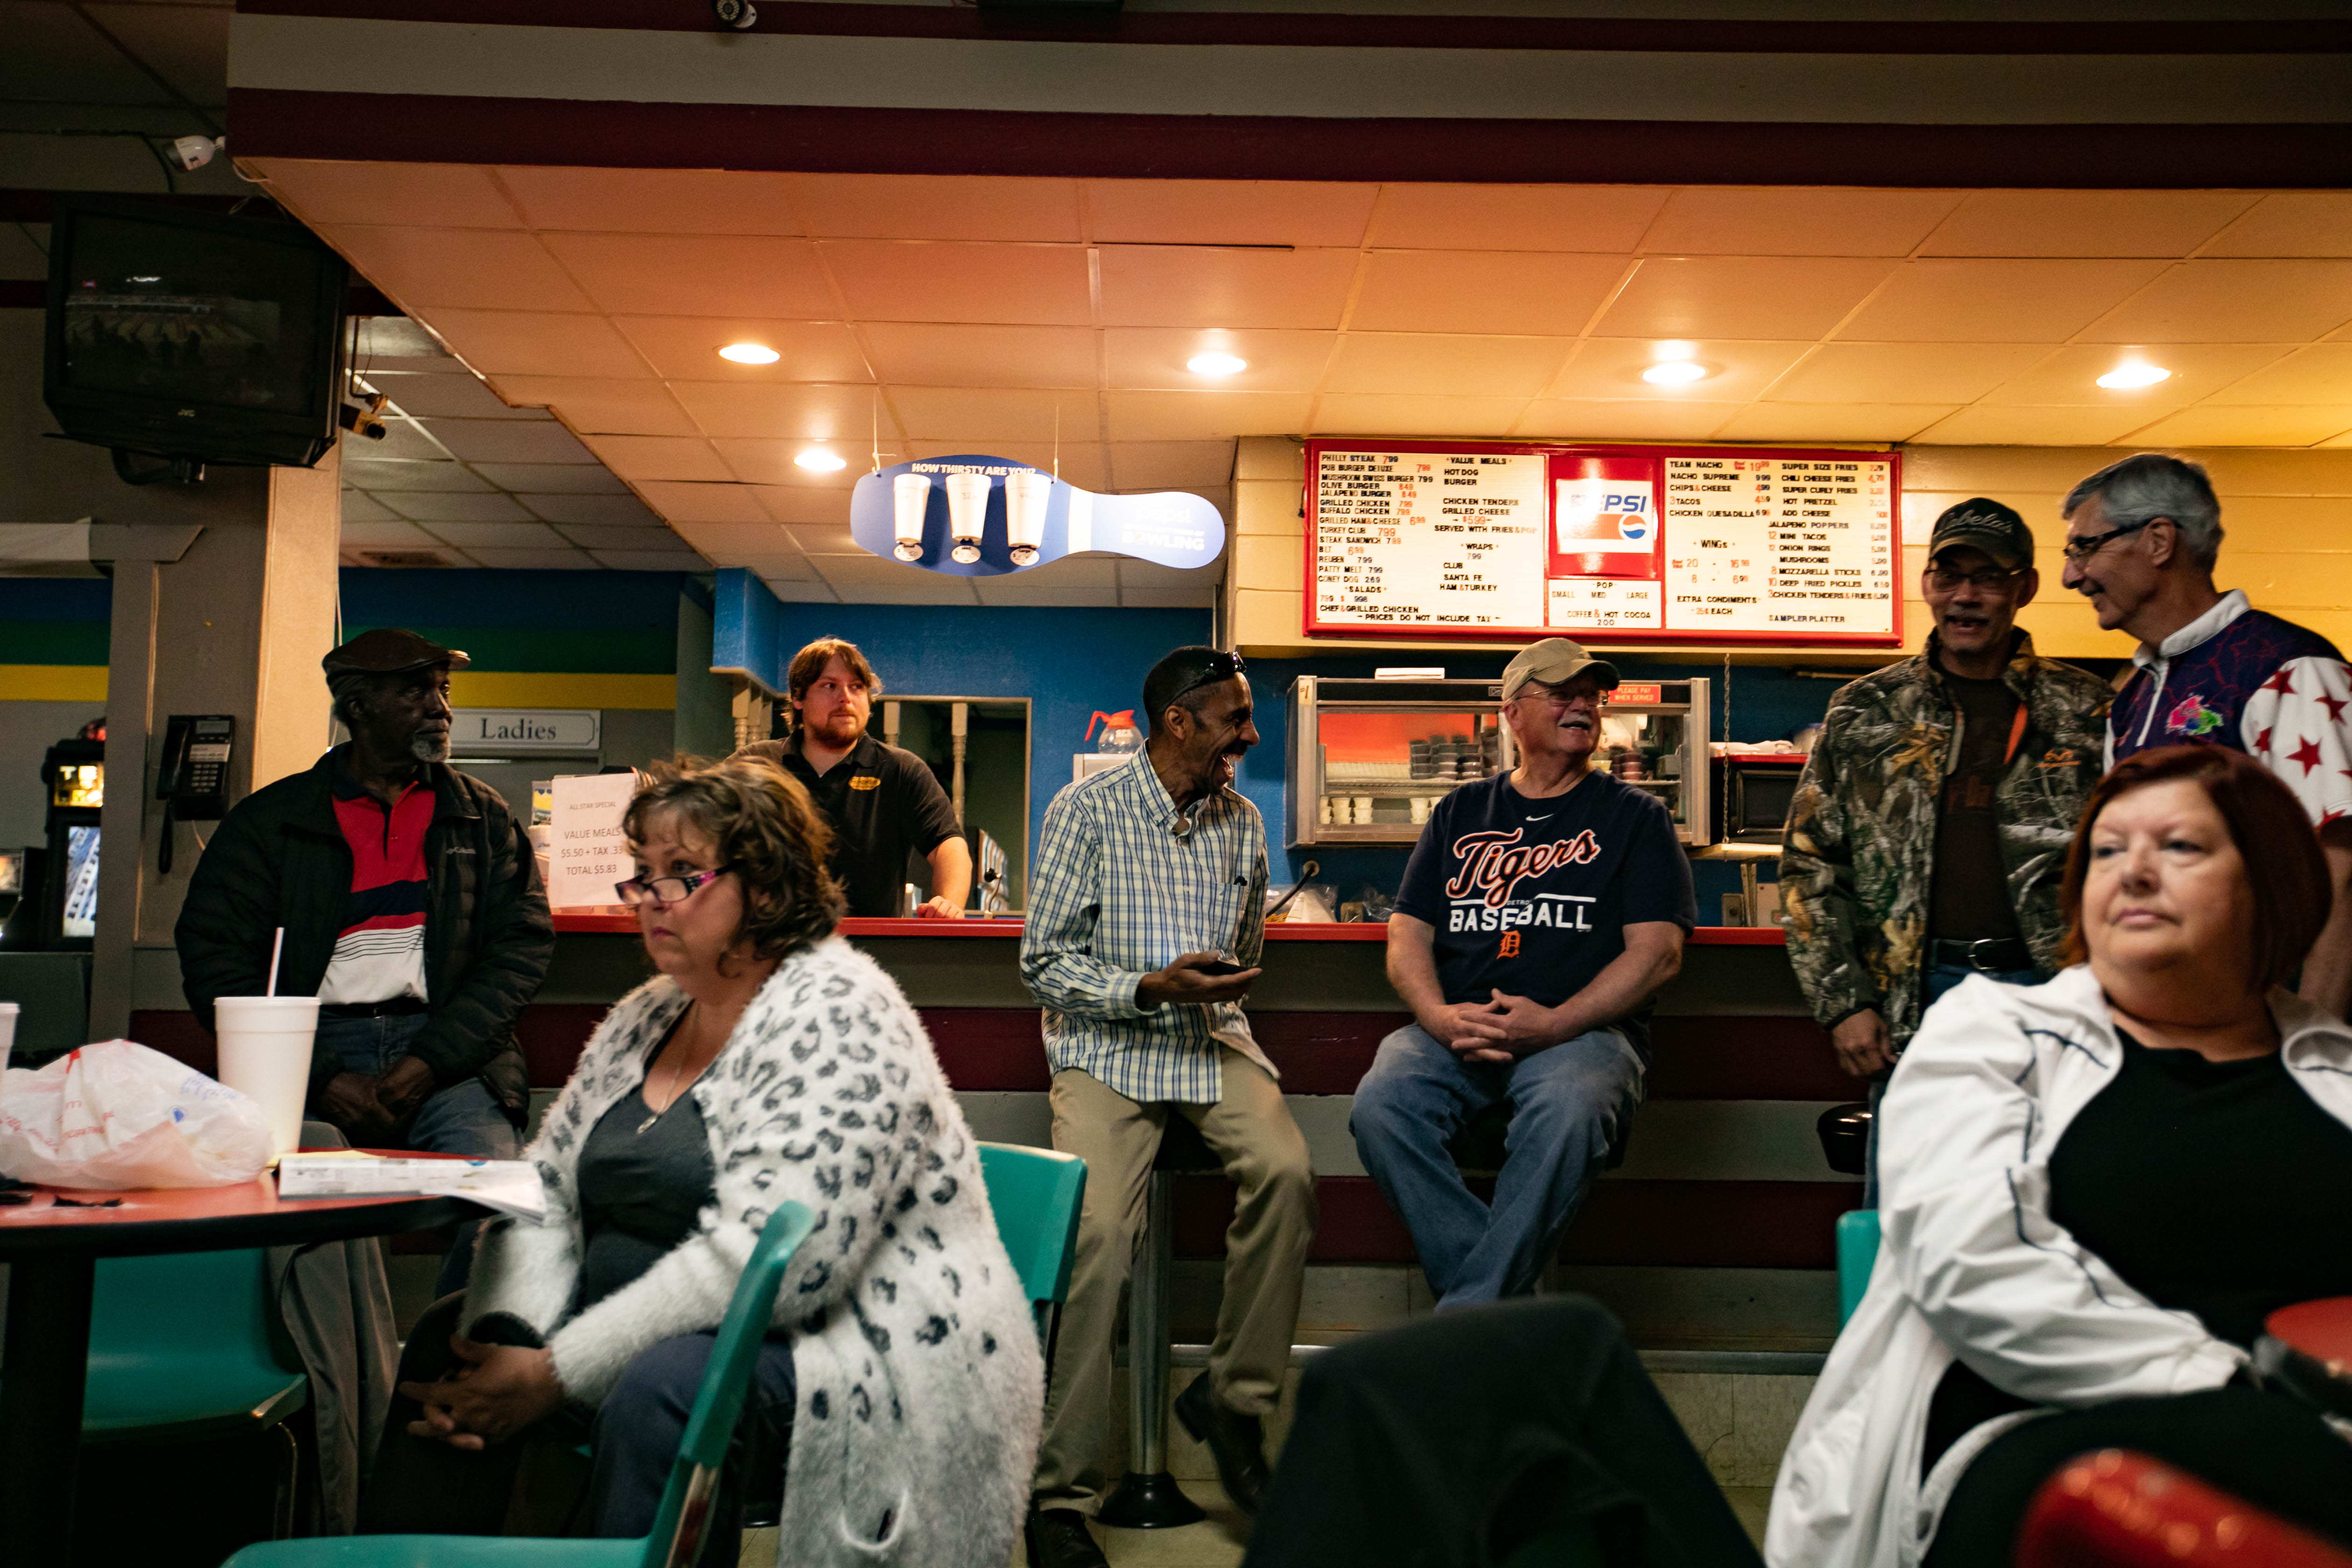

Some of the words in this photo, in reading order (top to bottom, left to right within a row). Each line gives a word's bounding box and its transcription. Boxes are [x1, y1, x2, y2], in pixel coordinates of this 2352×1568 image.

[1383, 455, 1398, 464] 799
[912, 463, 939, 473] HOW
[940, 464, 986, 474] THIRSTY
[985, 466, 1007, 476] ARE
[1687, 559, 1698, 567] 20
[481, 717, 556, 740] Ladies
[564, 830, 590, 839] VALUE
[593, 828, 621, 837] MEALS
[561, 848, 583, 858] $5.50
[567, 866, 592, 875] TOTAL
[595, 865, 616, 874] $5.83
[1446, 827, 1602, 909] Tigers
[1449, 903, 1592, 931] BASEBALL
[1496, 930, 1521, 959] D
